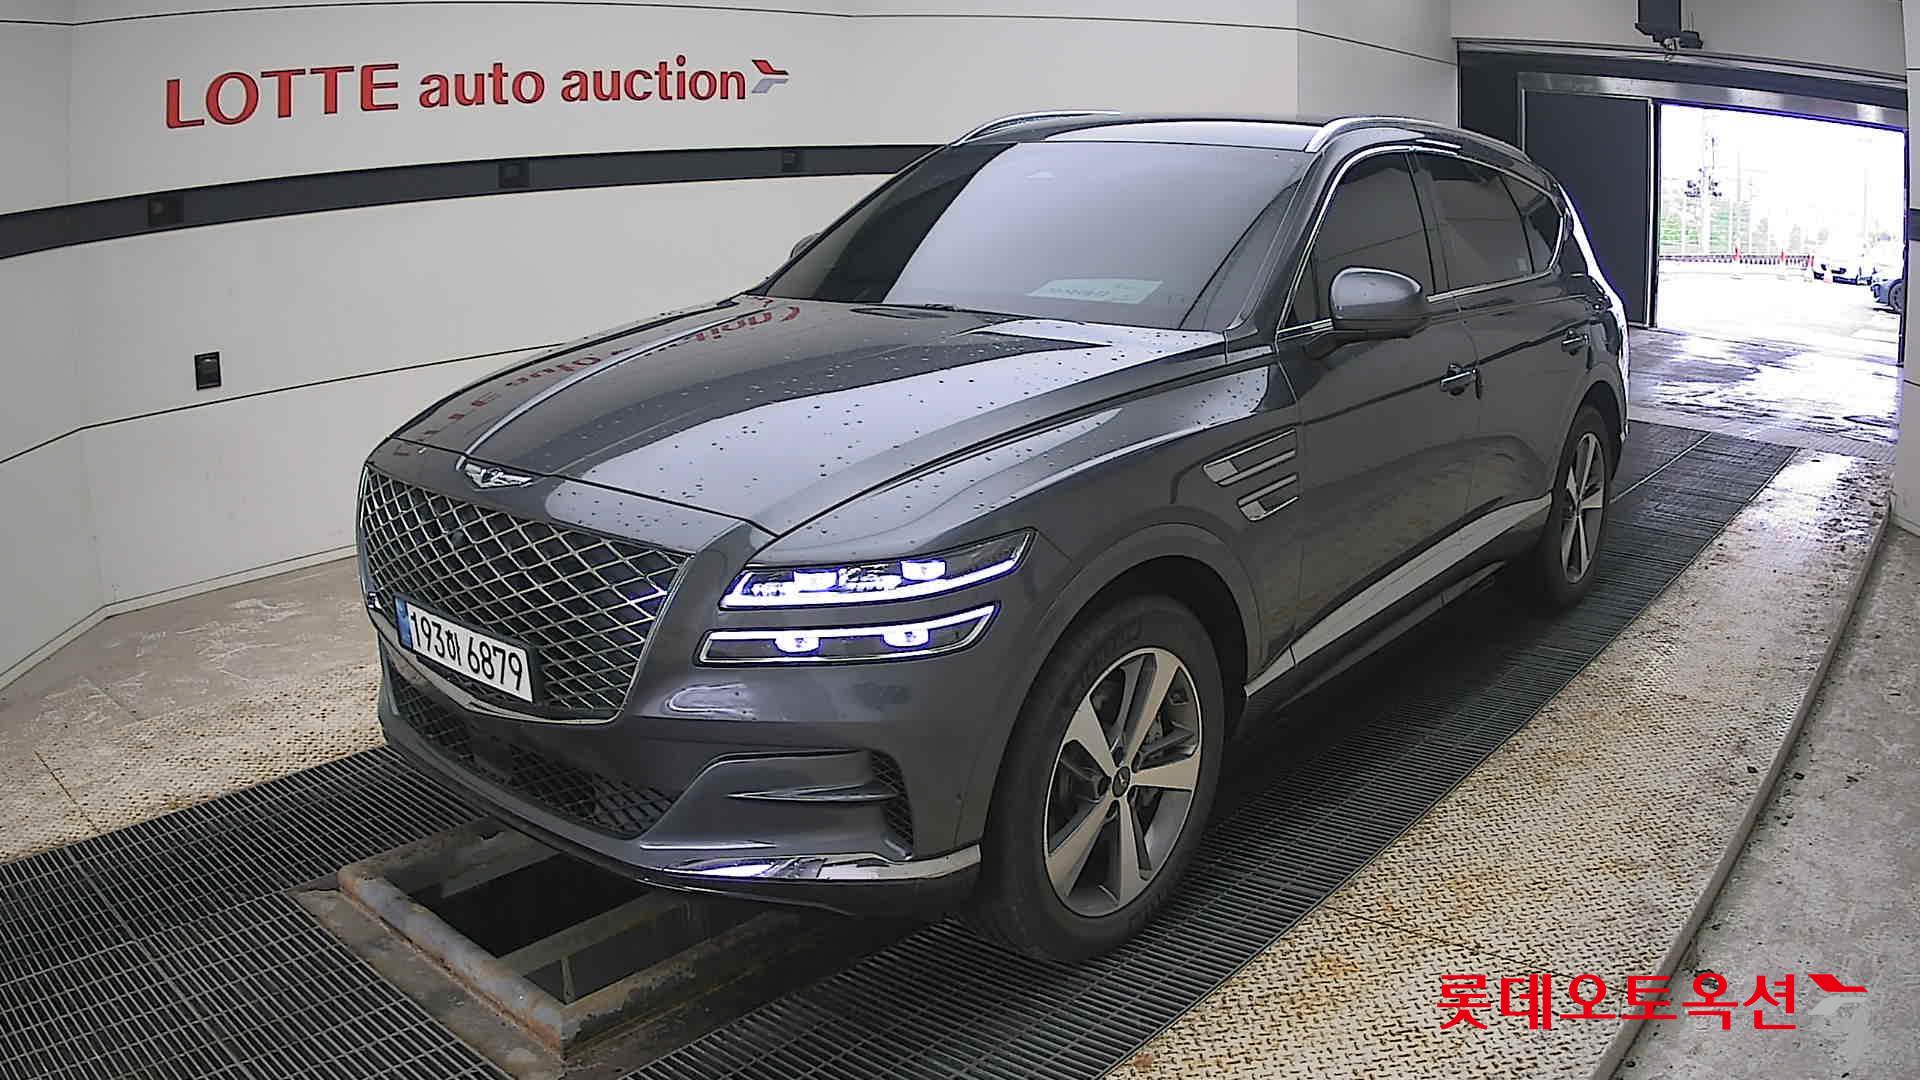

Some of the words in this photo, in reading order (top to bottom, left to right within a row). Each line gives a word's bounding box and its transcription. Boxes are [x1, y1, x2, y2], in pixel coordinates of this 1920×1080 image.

[165, 63, 399, 129] LOTTE
[418, 63, 546, 107] auto
[560, 55, 747, 102] auction
[410, 611, 462, 667] 193하
[467, 637, 523, 691] 6879
